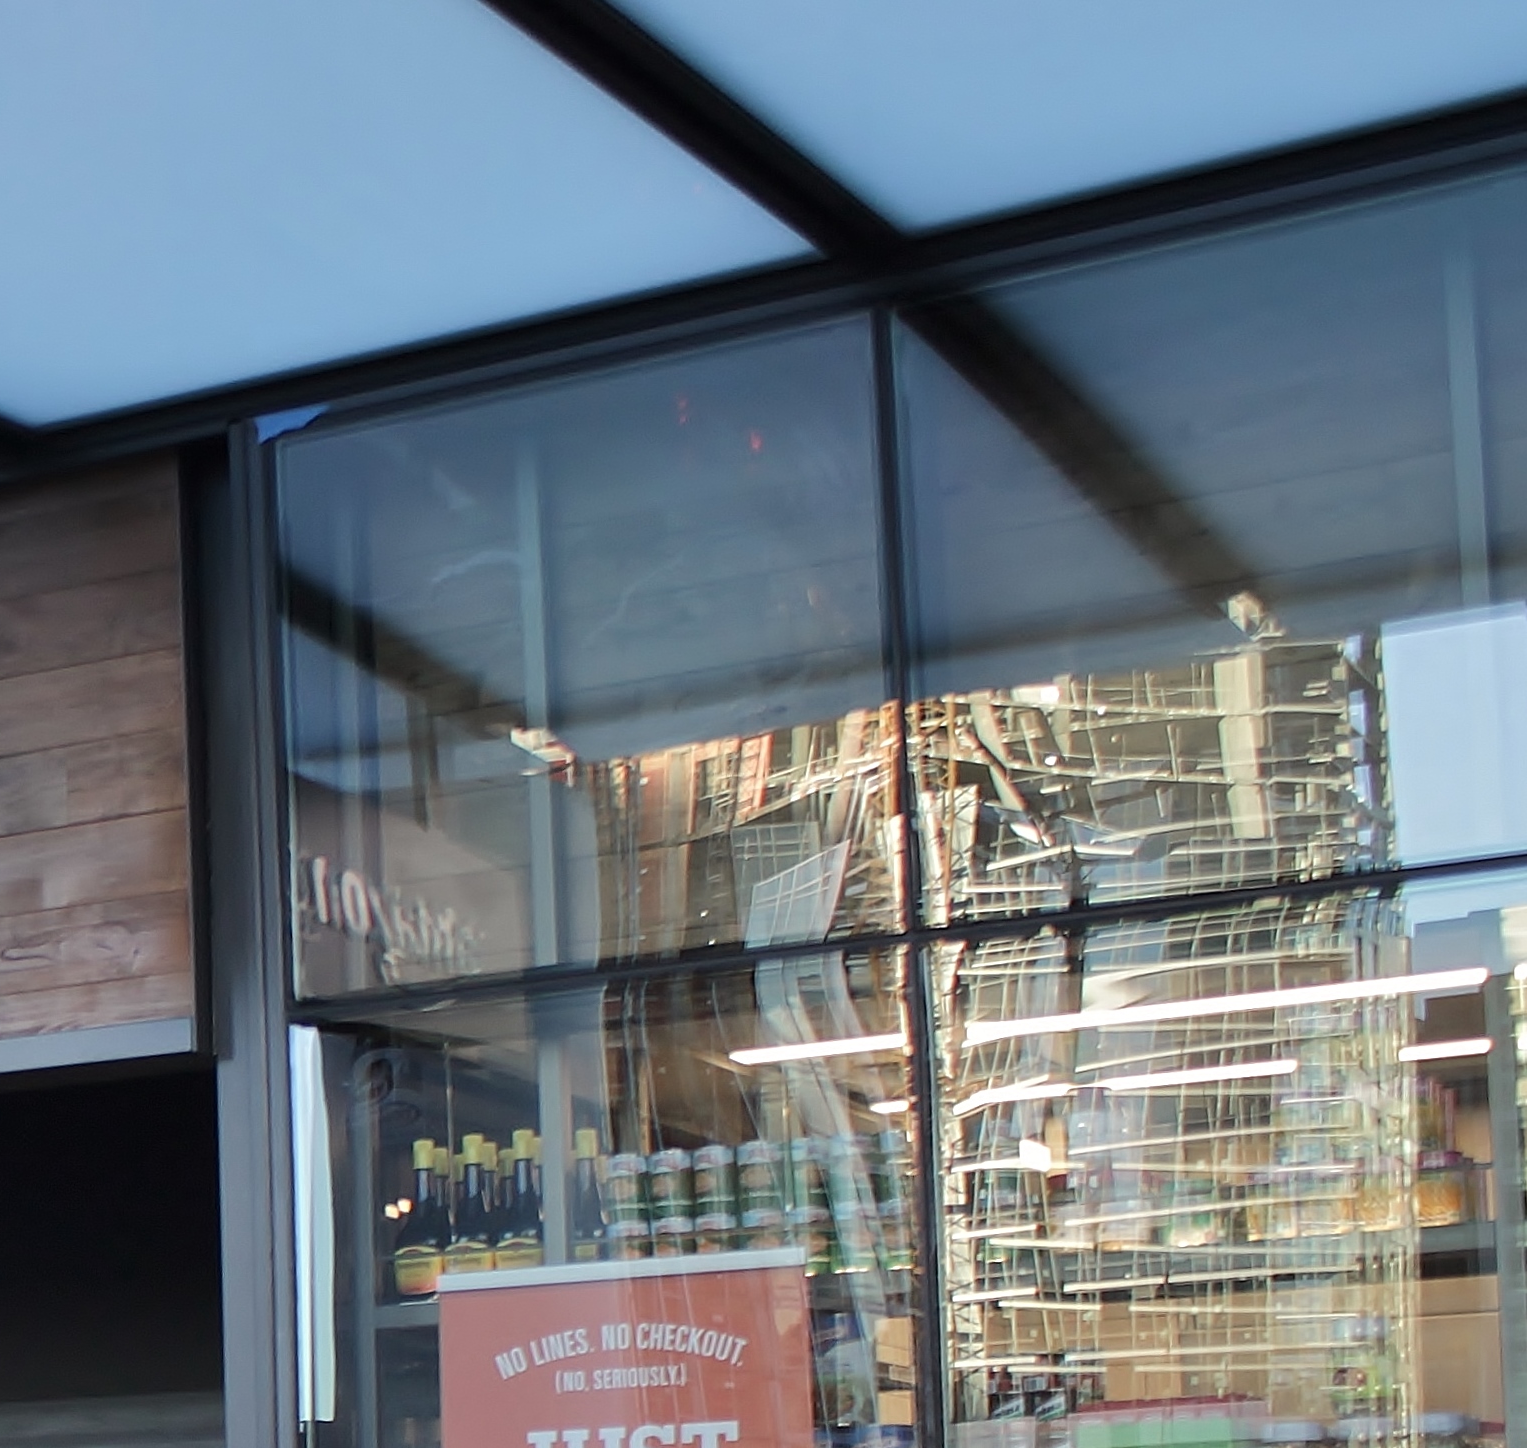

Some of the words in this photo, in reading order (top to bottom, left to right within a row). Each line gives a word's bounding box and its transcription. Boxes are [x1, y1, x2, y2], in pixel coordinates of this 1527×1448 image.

[495, 1346, 528, 1381] NO
[530, 1327, 595, 1366] LINES.
[601, 1322, 632, 1351] NO
[636, 1322, 748, 1367] CHECKOUT.
